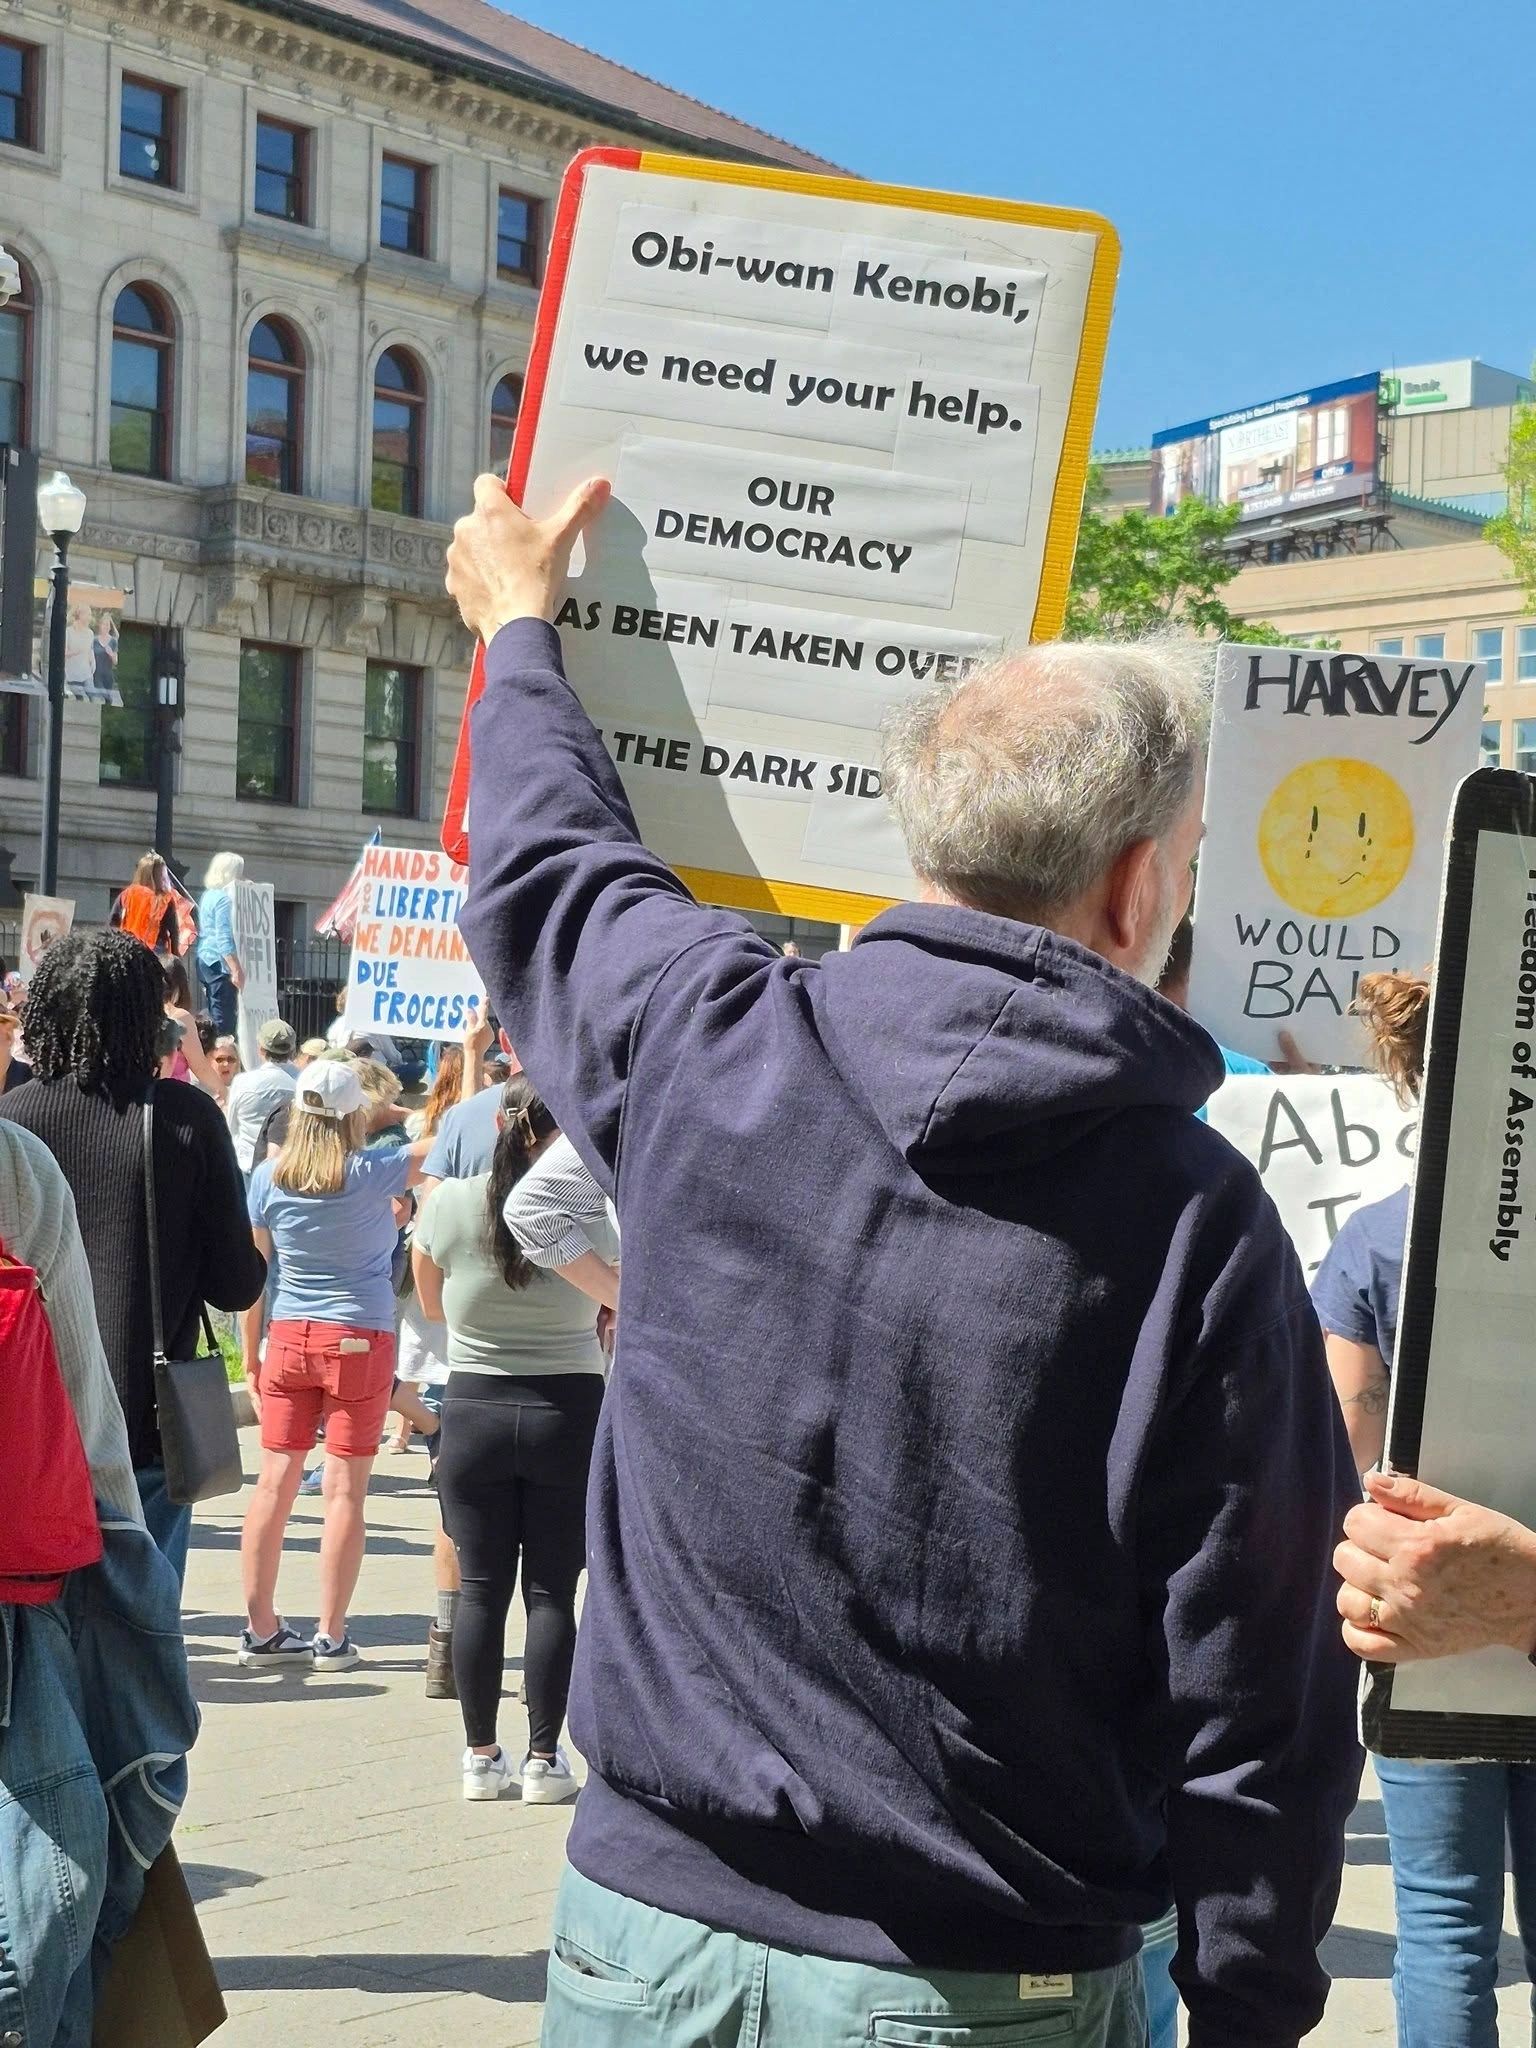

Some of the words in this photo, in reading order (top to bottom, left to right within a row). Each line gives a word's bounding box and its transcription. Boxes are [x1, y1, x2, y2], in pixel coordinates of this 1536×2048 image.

[631, 231, 834, 293] Obi-wan
[853, 260, 1031, 324] Kenobi,
[584, 343, 648, 377] we
[661, 354, 776, 396] need
[786, 371, 895, 412] your
[907, 381, 1023, 435] help.
[747, 476, 835, 517] OUR
[655, 508, 912, 574] DEMOCRACY
[553, 597, 602, 632] AS
[612, 605, 719, 648] BEEN
[729, 623, 863, 670] TAKEN
[1243, 653, 1476, 746] HARVEY
[613, 731, 691, 771] THE
[700, 745, 818, 791] DARK
[826, 763, 883, 800] SID
[363, 850, 440, 882] HANDS
[355, 922, 383, 954] WE
[388, 924, 471, 962] DEMAN
[1235, 913, 1400, 960] WOULD
[357, 959, 399, 988] DUE
[1511, 1041, 1536, 1079] of
[1488, 1086, 1535, 1262] Assembly
